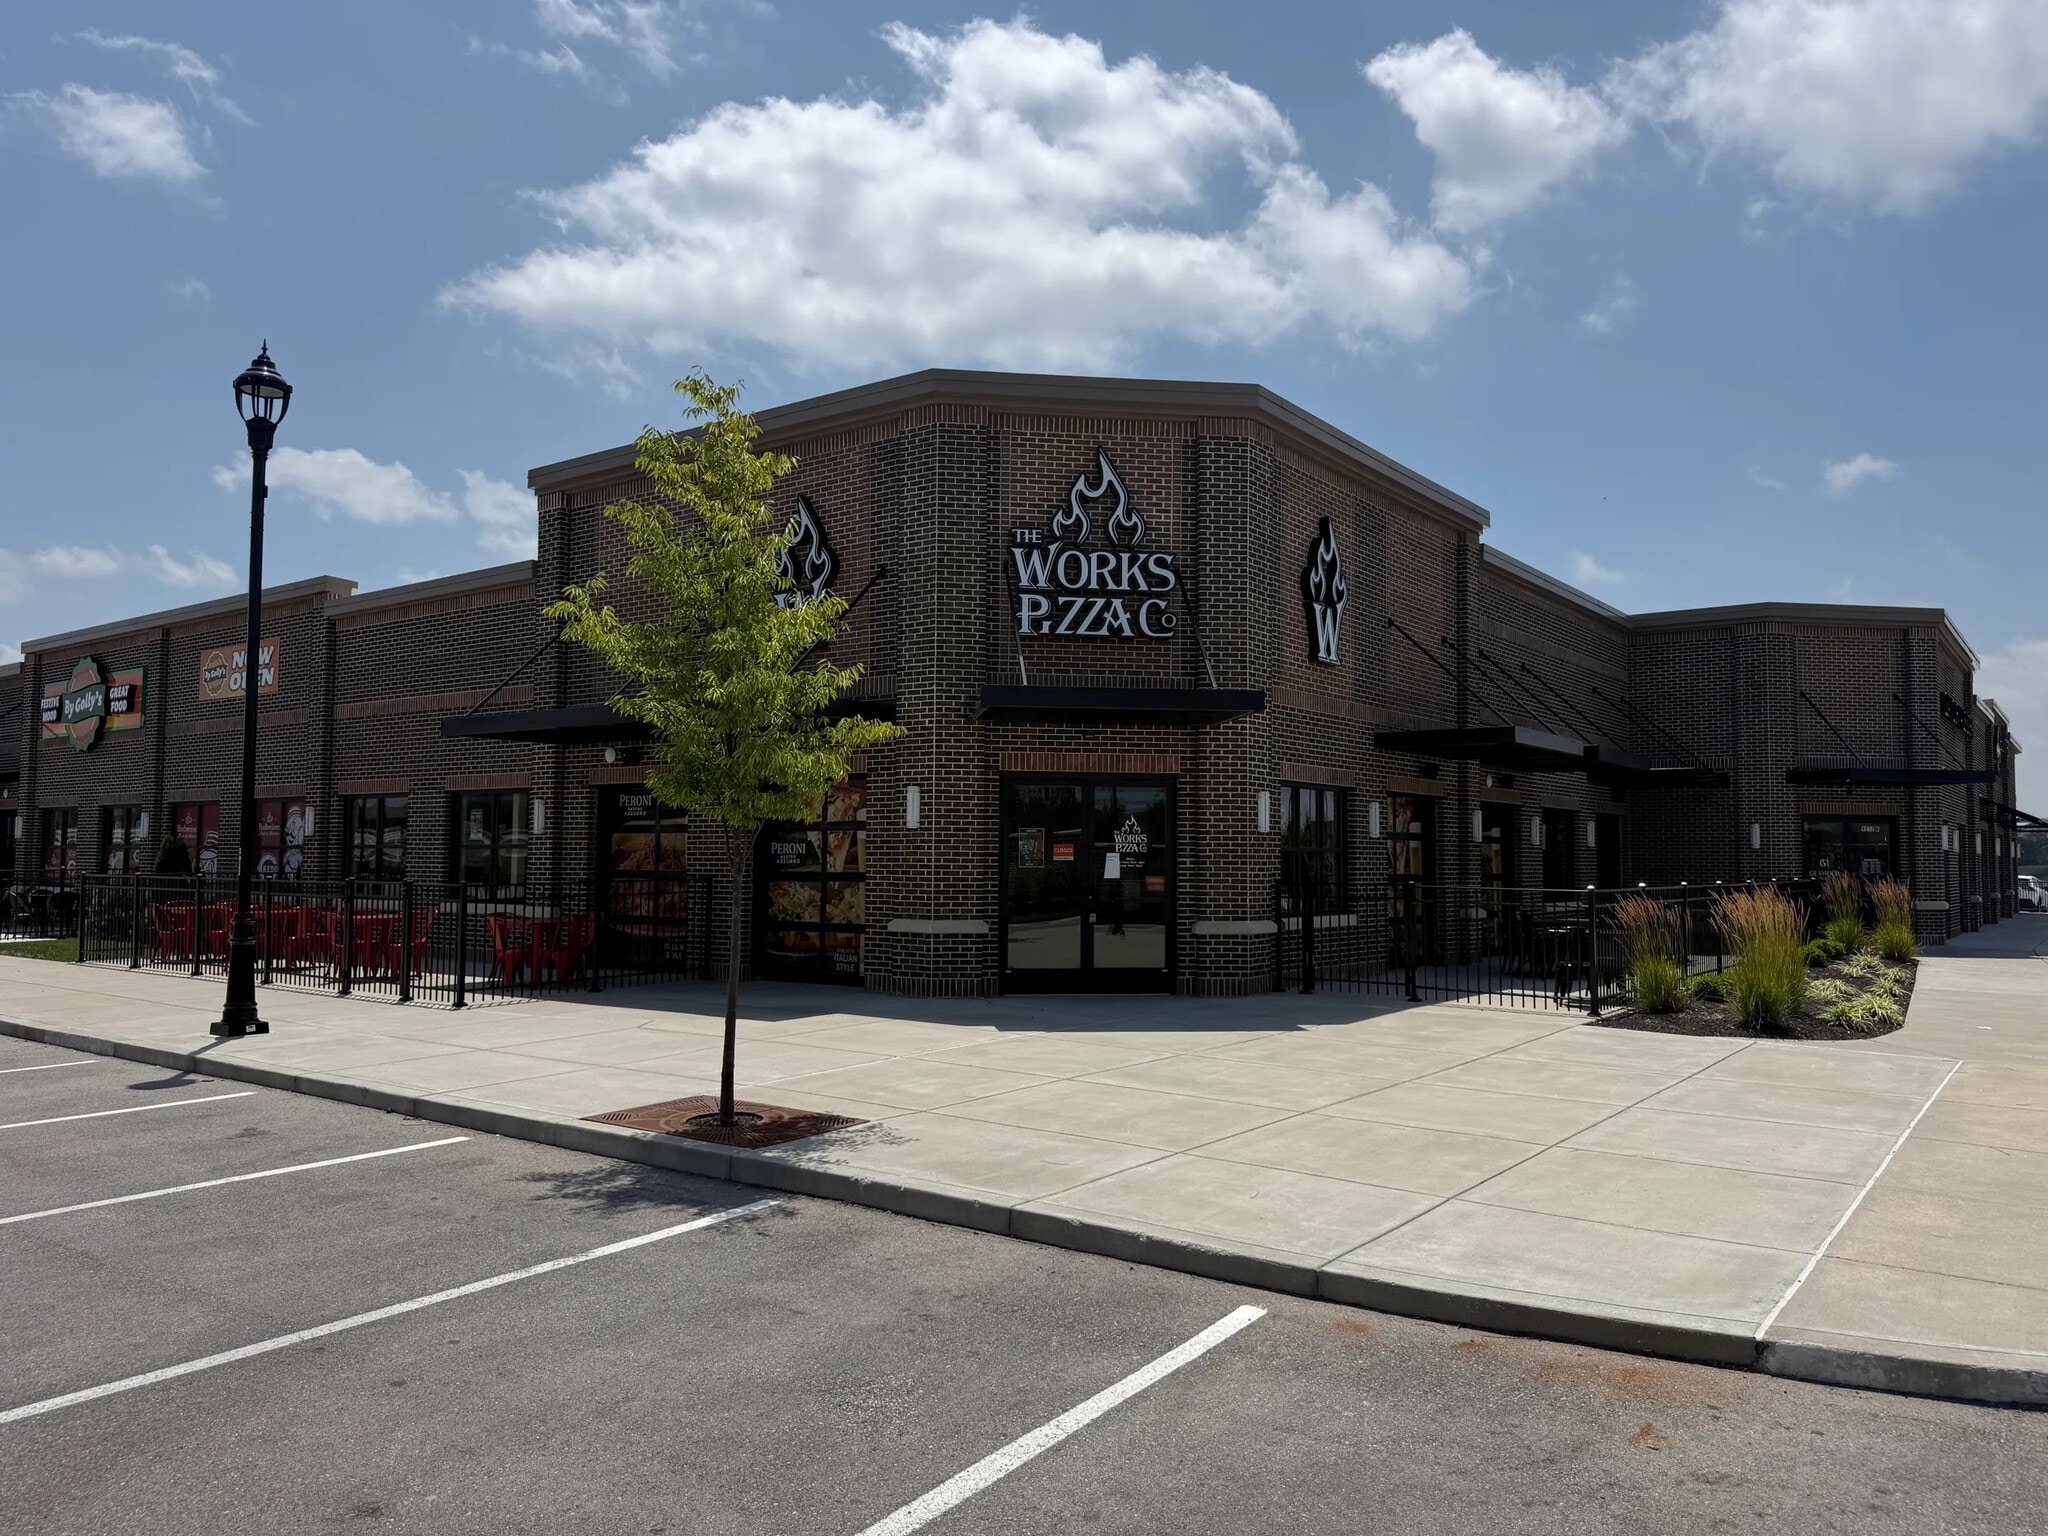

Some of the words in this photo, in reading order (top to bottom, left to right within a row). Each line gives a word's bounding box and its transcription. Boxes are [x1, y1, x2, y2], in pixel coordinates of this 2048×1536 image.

[1012, 528, 1042, 543] THE
[1010, 541, 1177, 591] WORKS
[1016, 594, 1135, 636] PIZZA
[1313, 597, 1348, 665] W
[232, 645, 275, 669] NW
[109, 685, 130, 699] GREAT
[40, 696, 60, 709] FESTIVE
[64, 699, 75, 719] By
[75, 690, 103, 713] Golly's
[110, 699, 128, 713] FOOD
[619, 794, 652, 807] PERONI
[1114, 832, 1148, 843] WORKS
[771, 842, 806, 854] PERONI
[1115, 843, 1139, 853] PIZZA
[833, 953, 858, 962] ITALIAN
[836, 963, 855, 972] STYLE
